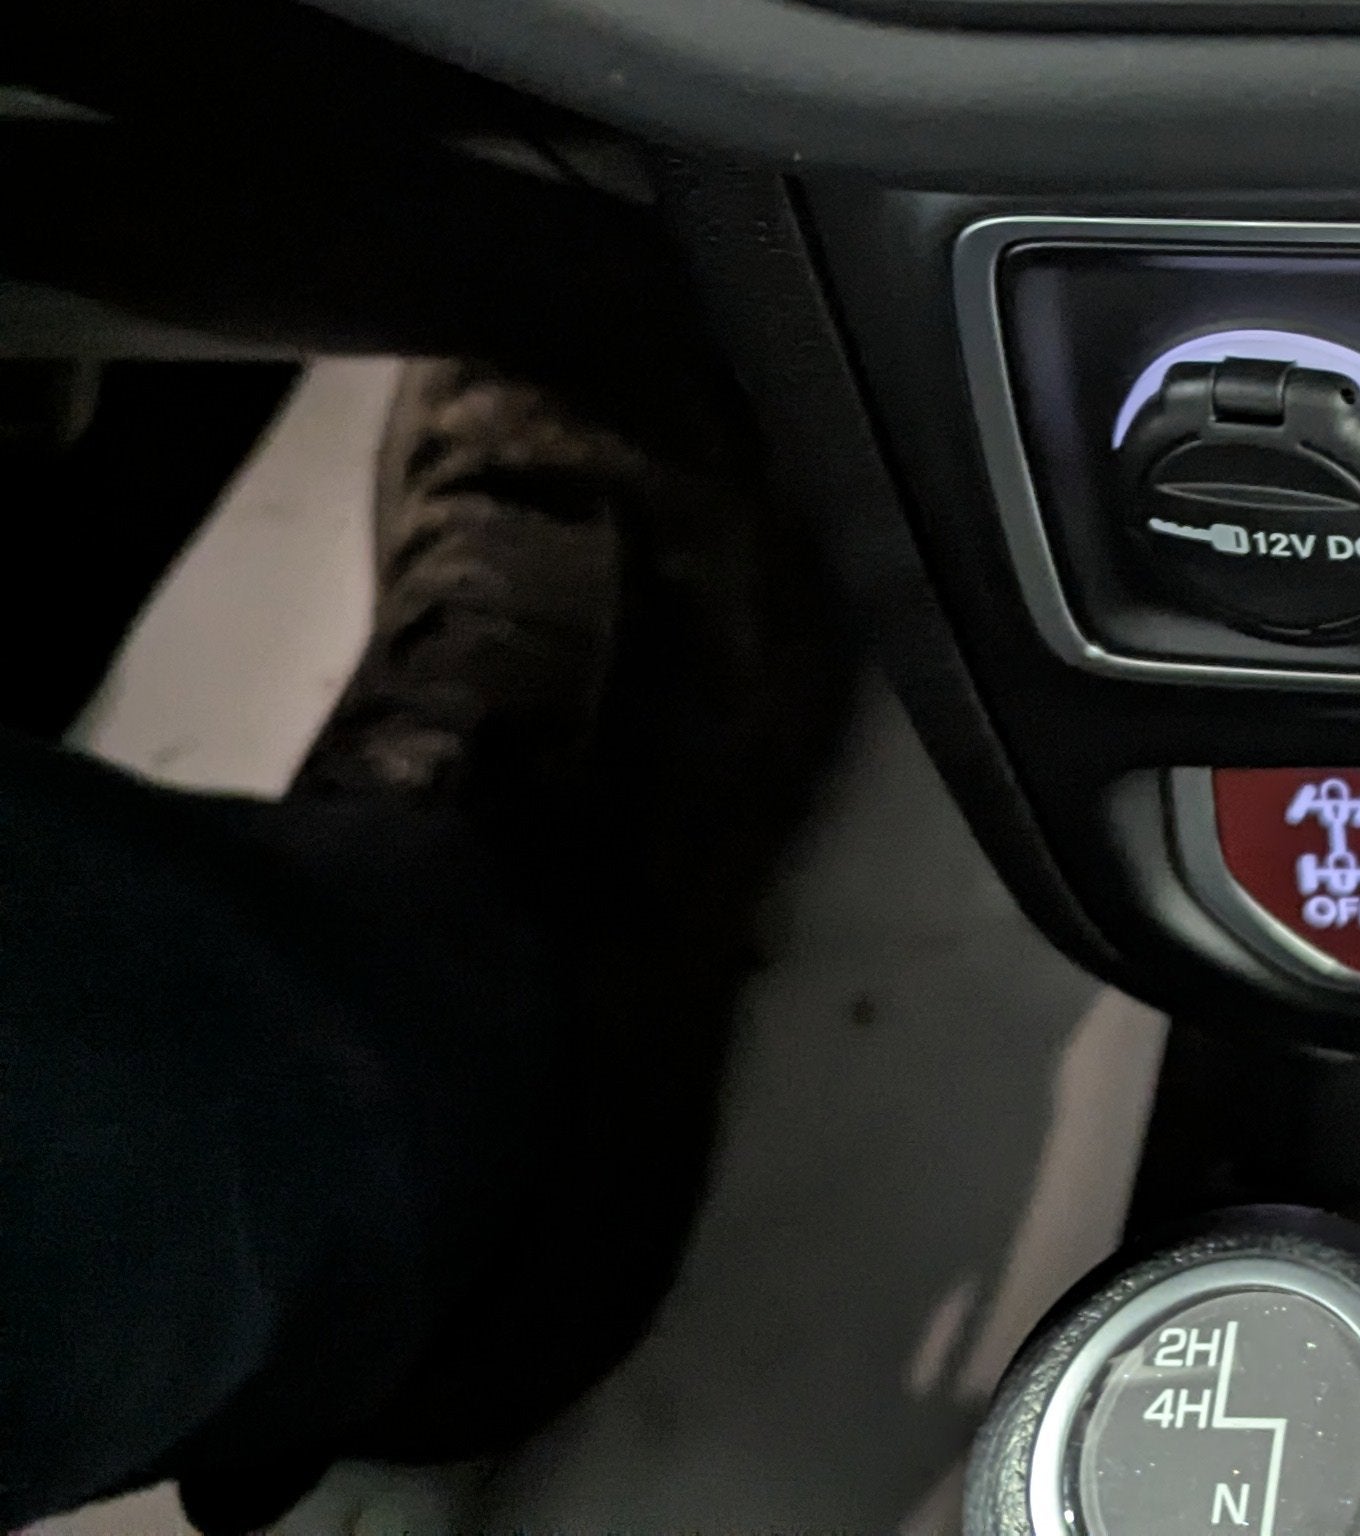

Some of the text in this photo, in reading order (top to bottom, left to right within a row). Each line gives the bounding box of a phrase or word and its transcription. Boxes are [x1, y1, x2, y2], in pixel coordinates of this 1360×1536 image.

[1252, 531, 1317, 559] 12V
[1153, 1327, 1222, 1368] 2H
[1142, 1388, 1212, 1430] 4H
[1210, 1482, 1250, 1526] N
